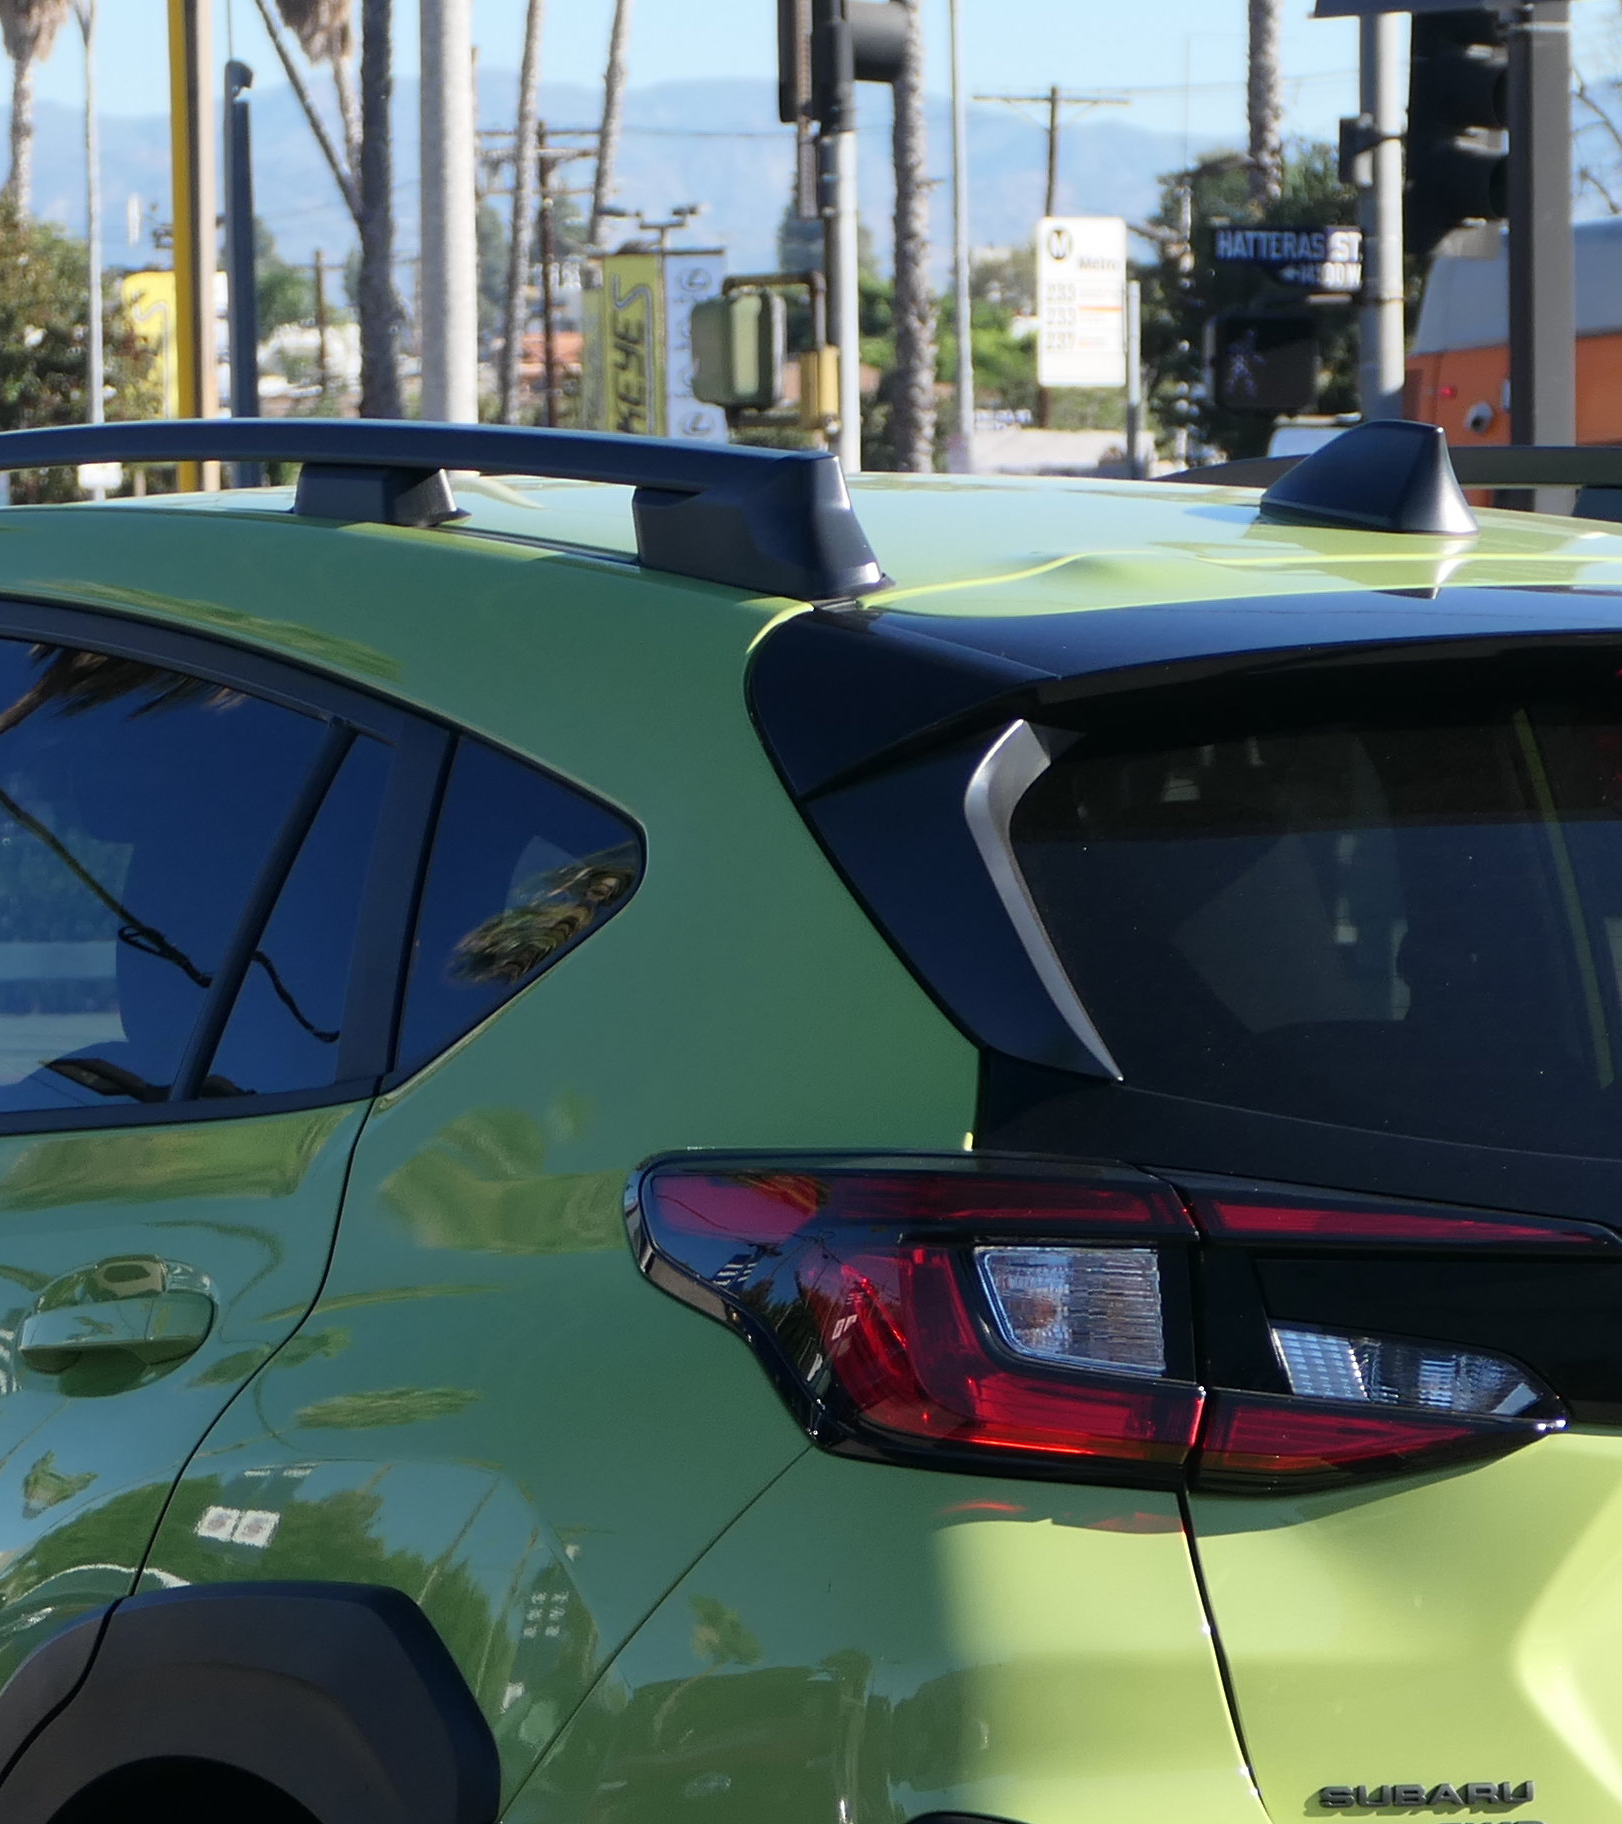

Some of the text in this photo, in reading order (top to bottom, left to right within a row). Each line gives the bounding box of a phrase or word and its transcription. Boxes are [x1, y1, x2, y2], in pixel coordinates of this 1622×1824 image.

[1215, 230, 1325, 260] HATTERAS
[1077, 256, 1122, 271] Metro
[1319, 1780, 1536, 1808] SUBARU
